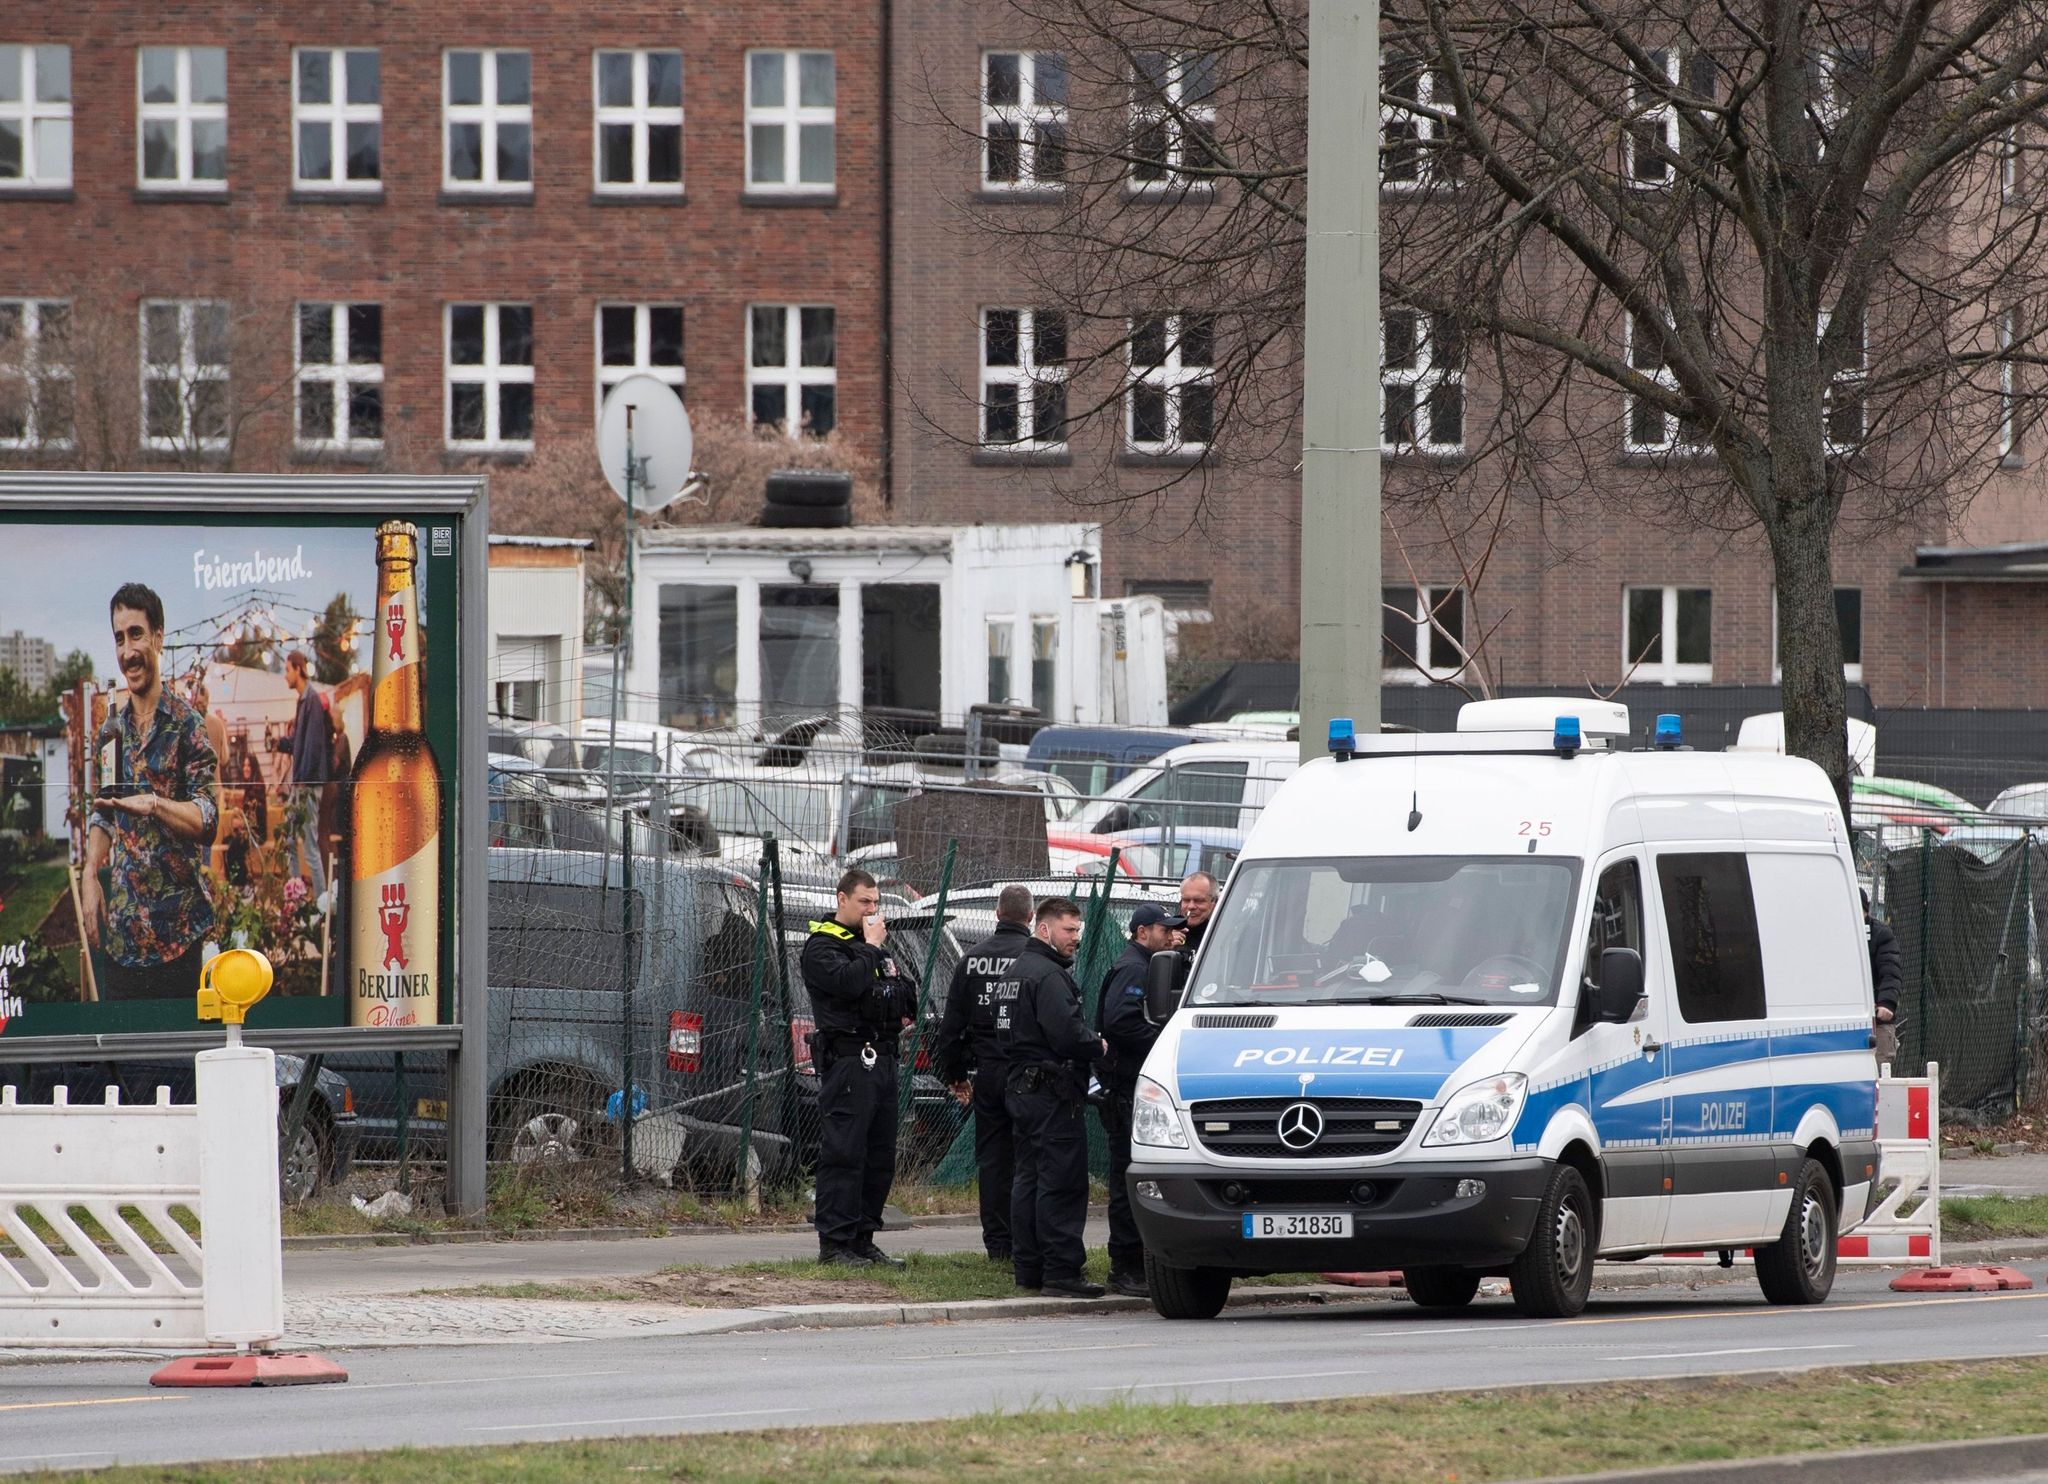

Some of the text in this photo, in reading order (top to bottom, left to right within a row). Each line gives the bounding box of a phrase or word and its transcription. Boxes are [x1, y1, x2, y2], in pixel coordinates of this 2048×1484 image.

[433, 529, 450, 539] BIER
[193, 544, 313, 590] Feierabend.
[966, 956, 1017, 976] POLIZ
[359, 967, 431, 1003] BERLINER
[986, 981, 998, 994] B
[366, 1005, 417, 1027] Pilsner
[1233, 1046, 1404, 1068] POLIZEI
[1701, 1101, 1746, 1131] POLIZEI
[1263, 1217, 1275, 1235] B
[1287, 1216, 1343, 1235] 31830
